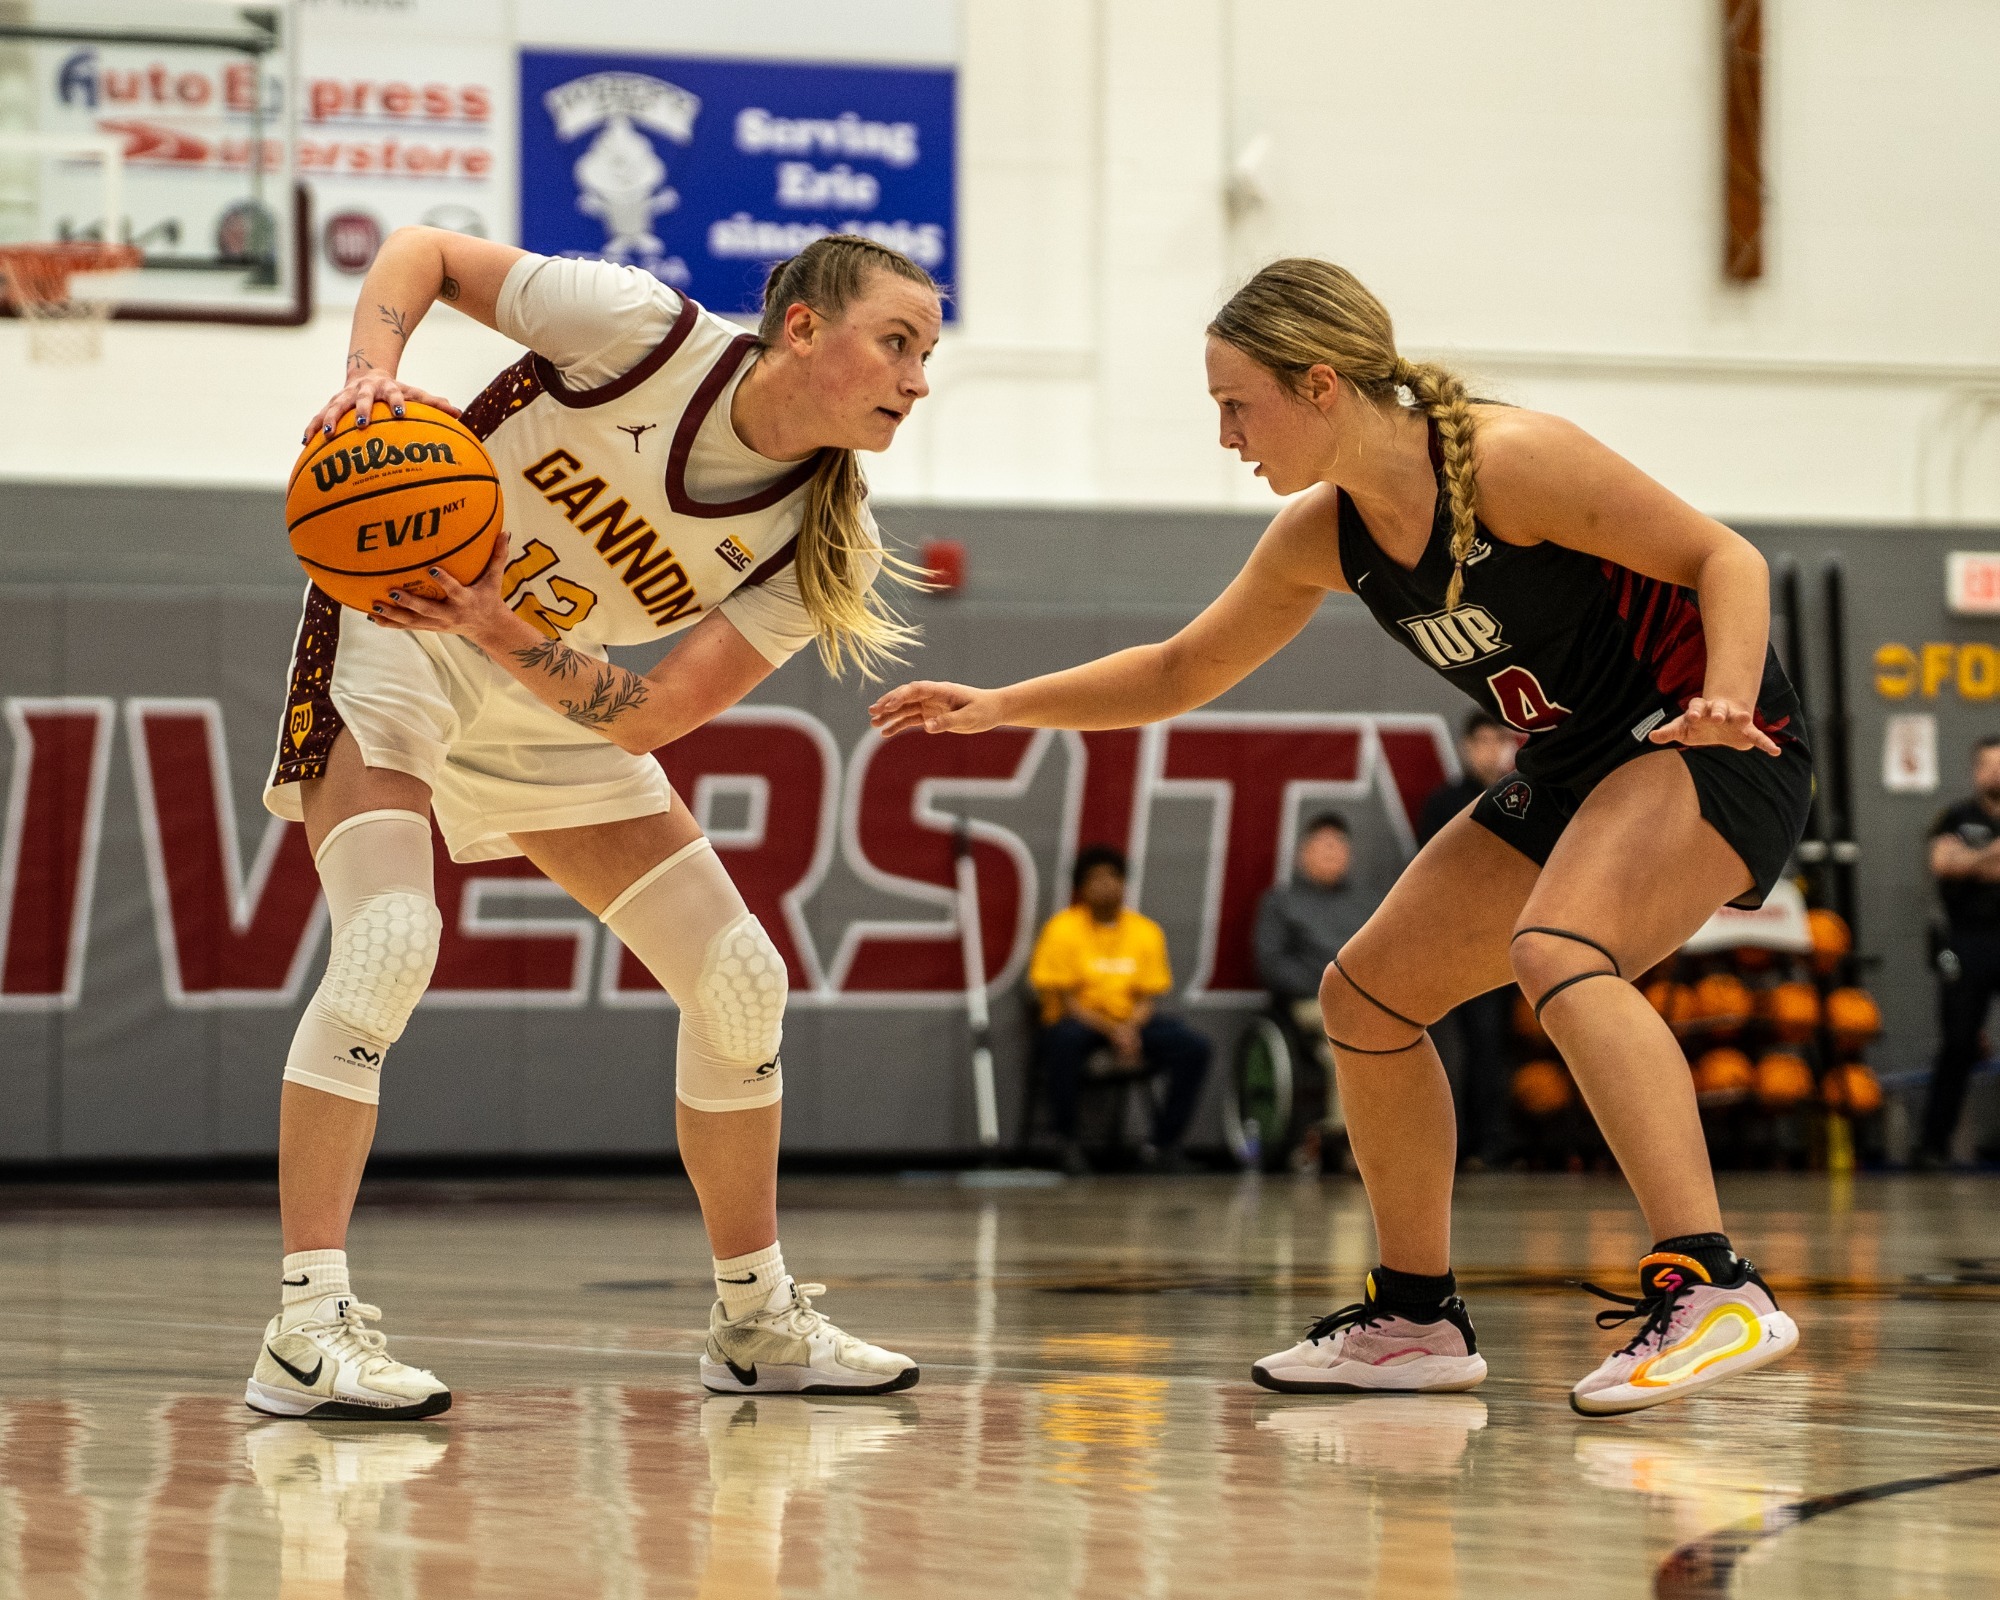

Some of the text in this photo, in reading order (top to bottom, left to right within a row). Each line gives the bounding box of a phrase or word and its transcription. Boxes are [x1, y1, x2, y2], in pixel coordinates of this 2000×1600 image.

[311, 437, 456, 492] Wilson
[352, 474, 379, 486] INDOOR
[356, 497, 466, 553] EVO NXT
[521, 447, 703, 628] GANNON
[719, 537, 752, 571] PSAC
[502, 538, 598, 642] 12
[1404, 604, 1508, 668] IUP
[1921, 642, 2000, 699] FO
[291, 708, 312, 735] GU
